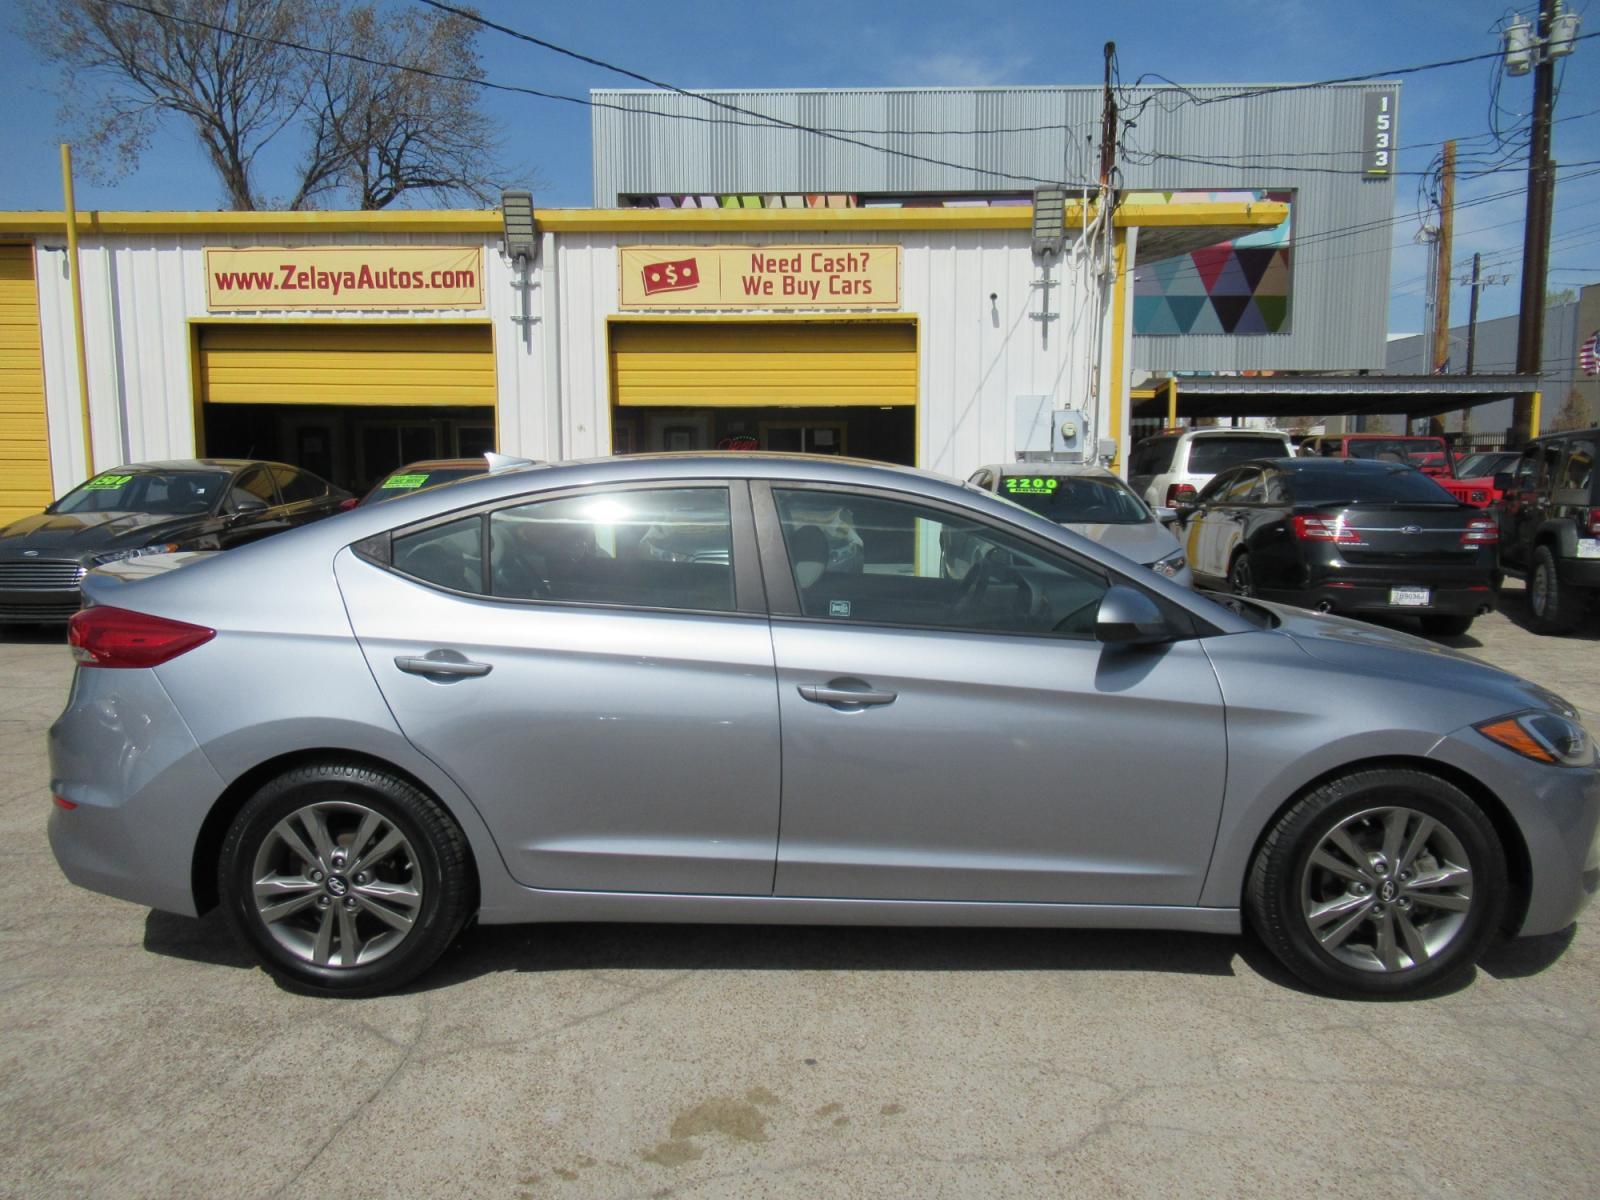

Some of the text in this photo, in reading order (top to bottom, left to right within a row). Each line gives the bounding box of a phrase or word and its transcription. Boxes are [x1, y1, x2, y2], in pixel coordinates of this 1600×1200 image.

[1375, 96, 1390, 167] 1533
[751, 252, 870, 273] Need Cash?
[214, 264, 475, 296] www.ZelayaAutos.com
[741, 274, 873, 301] We Buy Cars
[1006, 478, 1058, 489] 2200
